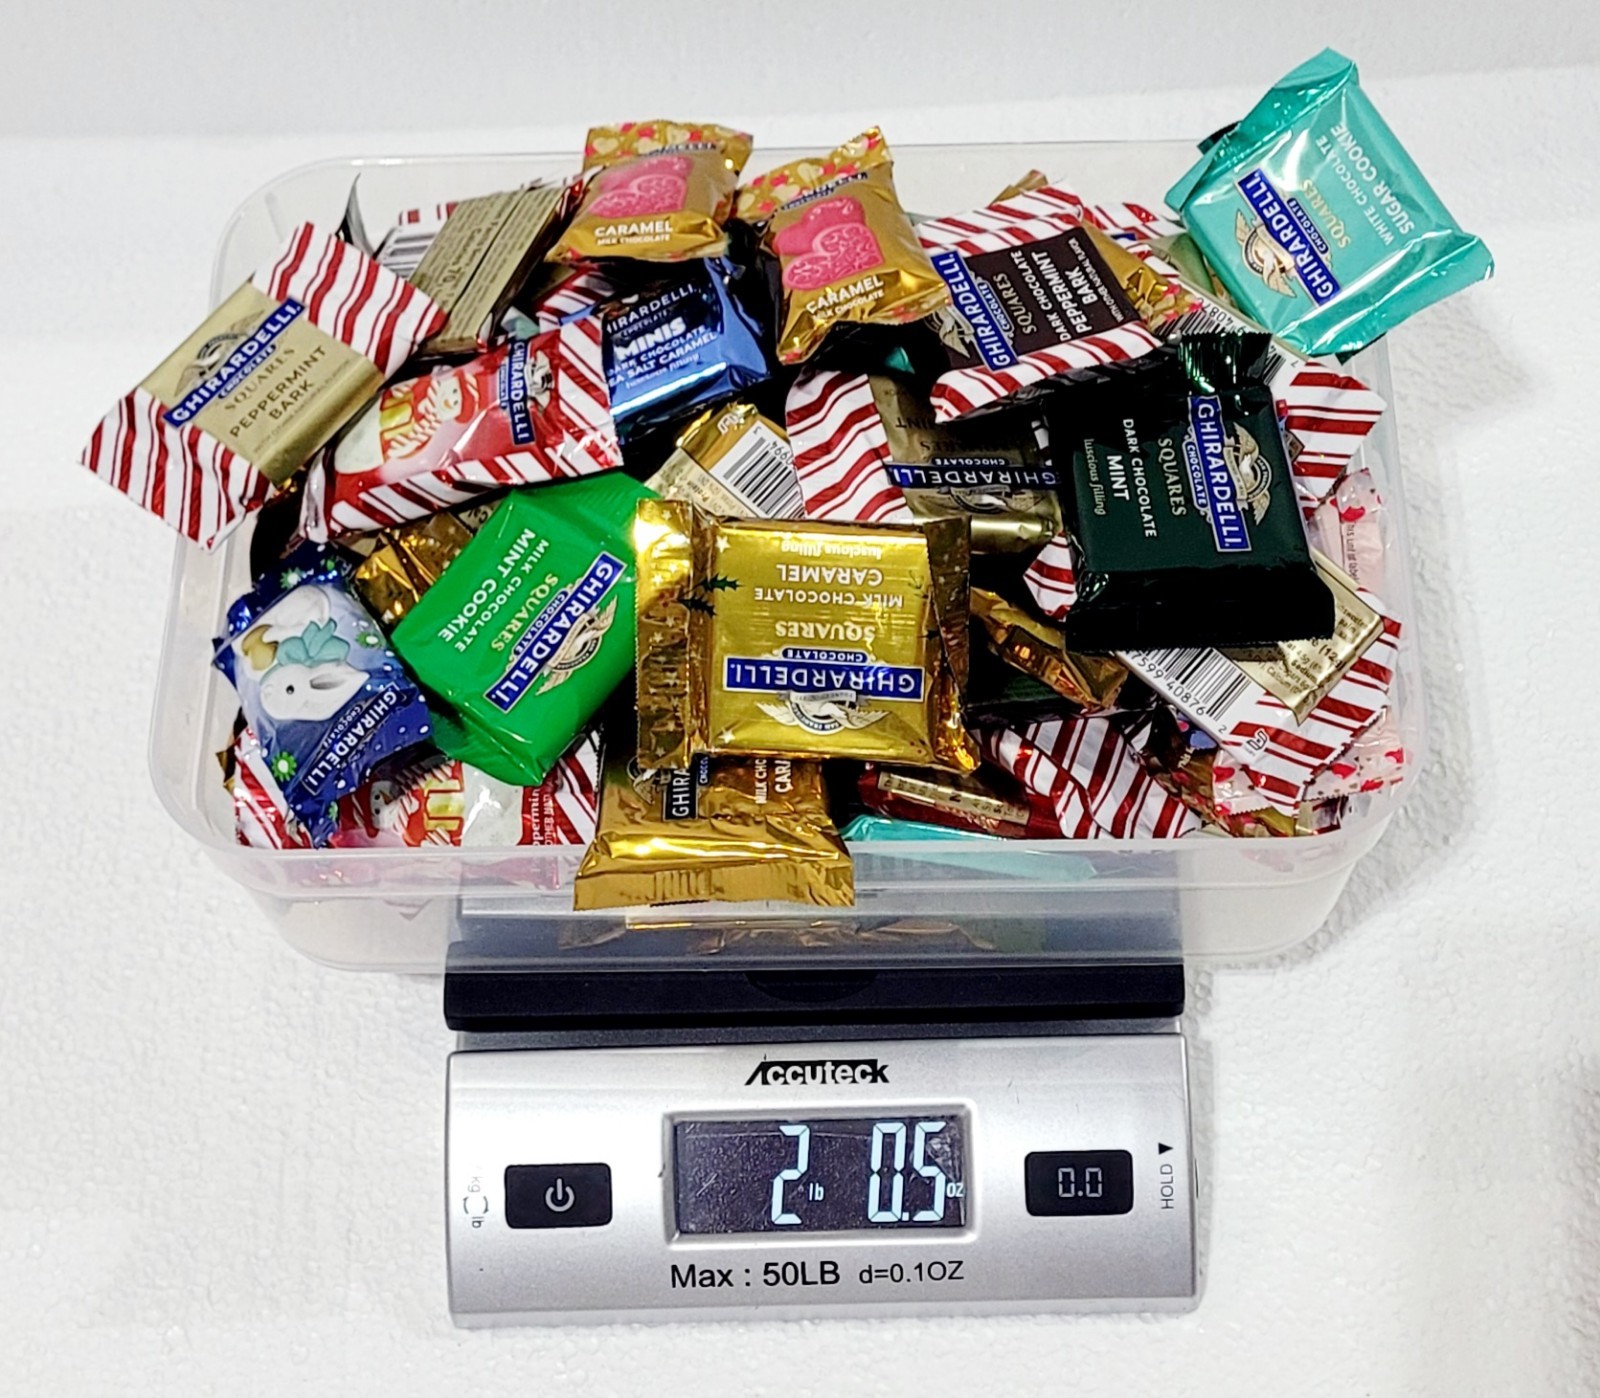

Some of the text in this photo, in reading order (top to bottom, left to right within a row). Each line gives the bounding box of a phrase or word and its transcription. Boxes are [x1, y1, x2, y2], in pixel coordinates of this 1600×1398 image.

[1316, 136, 1394, 245] WHITE CHOCOLATE
[1330, 124, 1414, 235] SUGAR COOKIE
[595, 221, 673, 238] CARAMEL
[1247, 172, 1332, 298] GHIRARDELLI
[1288, 200, 1327, 253] CHOCOLATE
[1301, 178, 1350, 249] SQUARES
[620, 234, 670, 245] CHOCOLATE
[806, 274, 884, 313] CARAMEL
[839, 290, 884, 315] CHOCOLATE
[937, 251, 1011, 366] GHIRARDELLI
[978, 281, 1011, 332] CHOCOLATE
[993, 273, 1036, 334] SQUARES
[1010, 250, 1071, 341] DARK CHOCOLATE
[1031, 252, 1092, 333] PEPPERMINT
[1065, 266, 1098, 305] BARK
[1097, 285, 1114, 305] OTHER
[171, 300, 301, 423] GHIRARDELLI
[614, 317, 686, 361] MINIS
[627, 360, 656, 379] SALT
[659, 332, 718, 365] CARAMEL
[640, 325, 706, 361] CHOCOLATE
[220, 346, 276, 399] CHOCOLATE
[225, 347, 295, 412] SQUARES
[230, 346, 326, 437] PEPPERMINT
[270, 380, 314, 422] BARK
[893, 467, 1056, 485] GHIRARDELLI
[935, 457, 1005, 466] CHOCOLATE
[1084, 438, 1106, 515] luscious filling
[1107, 455, 1129, 500] MINT
[1123, 419, 1157, 537] DARK CHOCOLATE
[1158, 438, 1187, 516] SQUARES
[1187, 444, 1207, 505] CHOCOLATE
[1199, 404, 1241, 546] GHIRARDELLI
[499, 528, 536, 580] MINT
[522, 539, 550, 577] MILK
[776, 565, 883, 585] CARAMEL
[781, 543, 882, 560] luscious filling
[439, 579, 498, 641] COOKIE
[454, 577, 522, 652] CHOCOLATE
[492, 573, 559, 651] SQUARES
[515, 592, 566, 654] CHOCOLATE
[754, 587, 903, 608] MILK CHOCOLATE
[490, 562, 613, 705] GHIRARDELLI
[775, 622, 876, 648] SQUARES
[787, 649, 863, 662] CHOCOLATE
[730, 664, 915, 692] GHIRARDELLI
[1131, 651, 1227, 734] 7599 40876 2
[307, 690, 397, 788] GHIRARDELLI
[322, 704, 361, 748] CHOCOLATE
[755, 778, 767, 803] MILK
[467, 1176, 482, 1193] kg
[771, 1124, 811, 1225] 2
[808, 1182, 824, 1201] lb
[867, 1121, 946, 1223] 0.5
[1057, 1167, 1103, 1198] 0.0
[1160, 1163, 1174, 1210] HOLD
[670, 1264, 734, 1289] Max
[762, 1261, 841, 1287] 50LB
